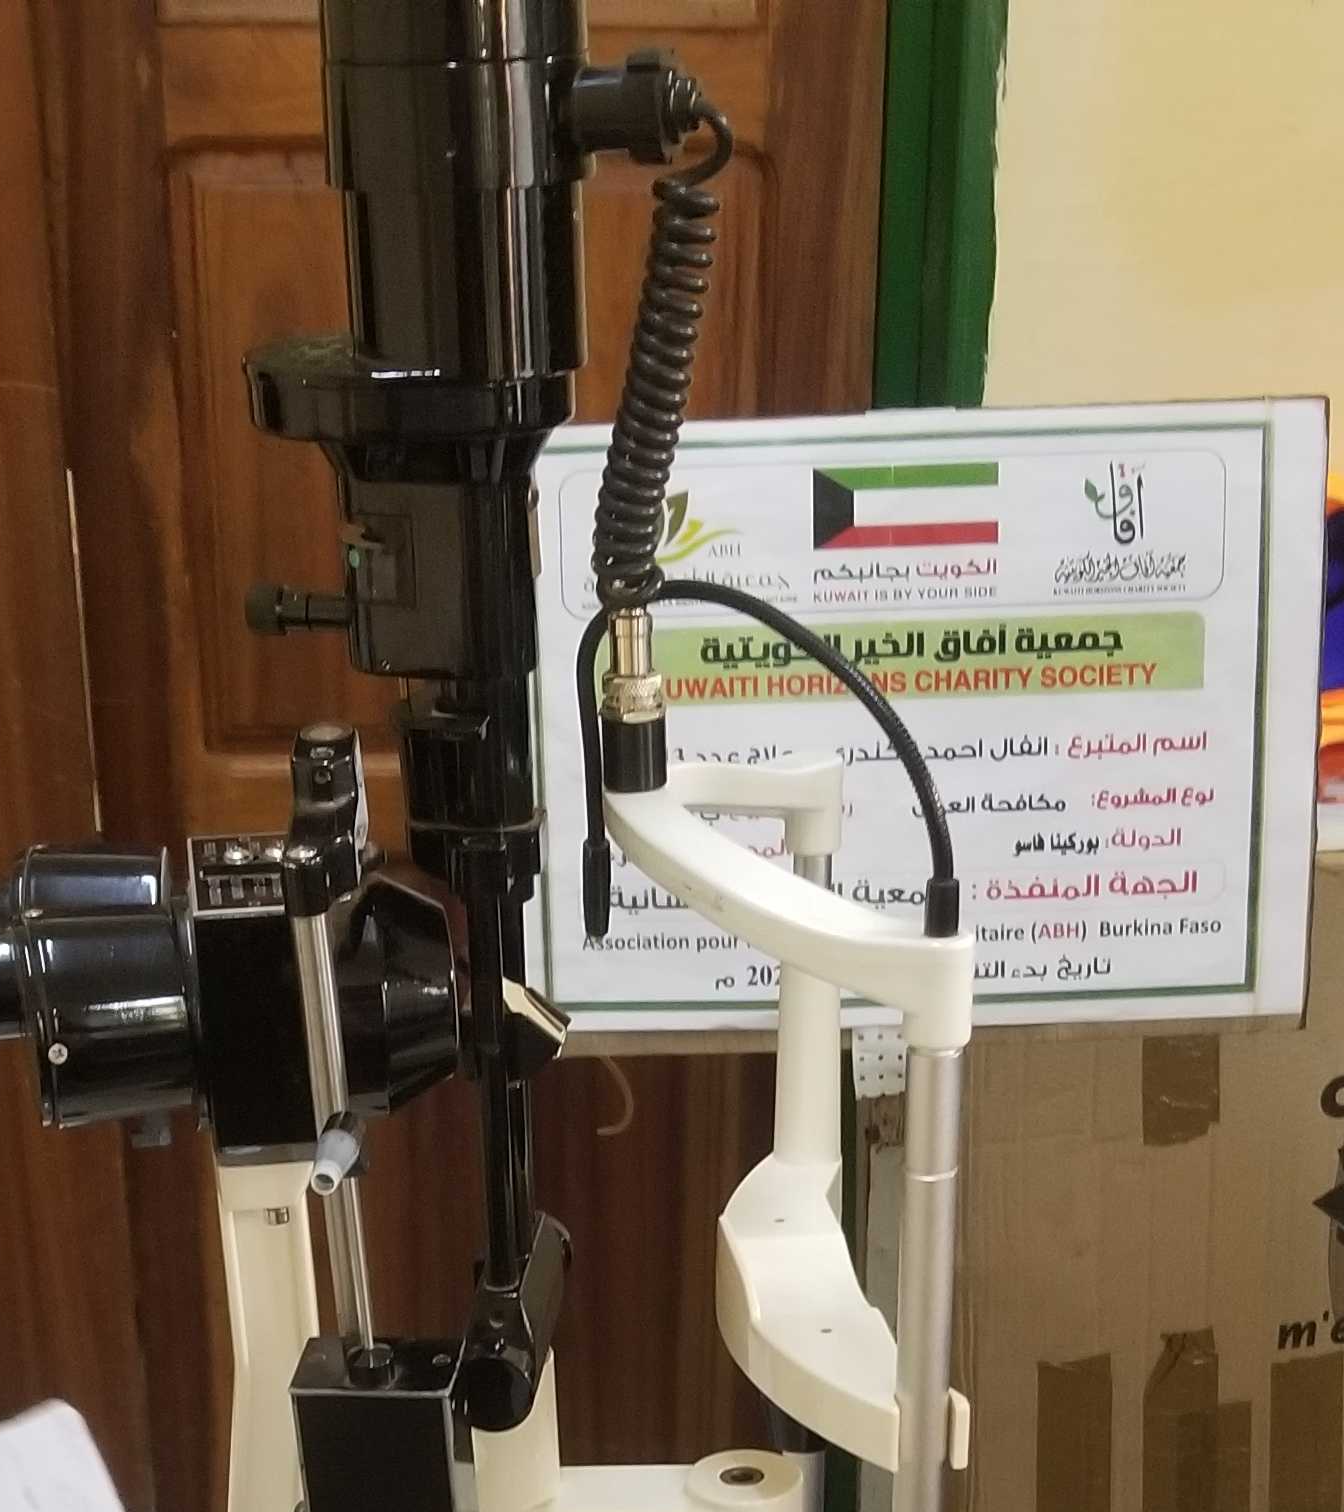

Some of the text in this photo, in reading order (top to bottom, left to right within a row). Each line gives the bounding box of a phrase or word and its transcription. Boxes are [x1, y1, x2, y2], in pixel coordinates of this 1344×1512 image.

[813, 557, 998, 586] الكويت بجانبكم
[813, 589, 868, 604] KUWAIT
[874, 588, 888, 601] IS
[893, 587, 912, 601] BY
[917, 586, 959, 600] YOUR
[964, 585, 997, 598] SIDE
[1014, 628, 1124, 660] جمعية
[665, 662, 1158, 700] UWAITI HORIZNS CHARITY SOCIETY
[923, 737, 983, 760] احمد
[1067, 733, 1147, 760] المتبرع
[1152, 731, 1207, 757] اسم
[980, 792, 1067, 812] مكافحة
[1180, 788, 1215, 807] نوع
[1049, 833, 1100, 857] بوركينا
[985, 873, 1100, 901] المنفذة
[1108, 869, 1198, 900] الجهة
[582, 931, 739, 952] Association pour
[1030, 920, 1088, 944] (ABH)
[1098, 919, 1173, 938] Burkina
[1179, 916, 1222, 936] Faso
[1056, 954, 1112, 981] تاريخ
